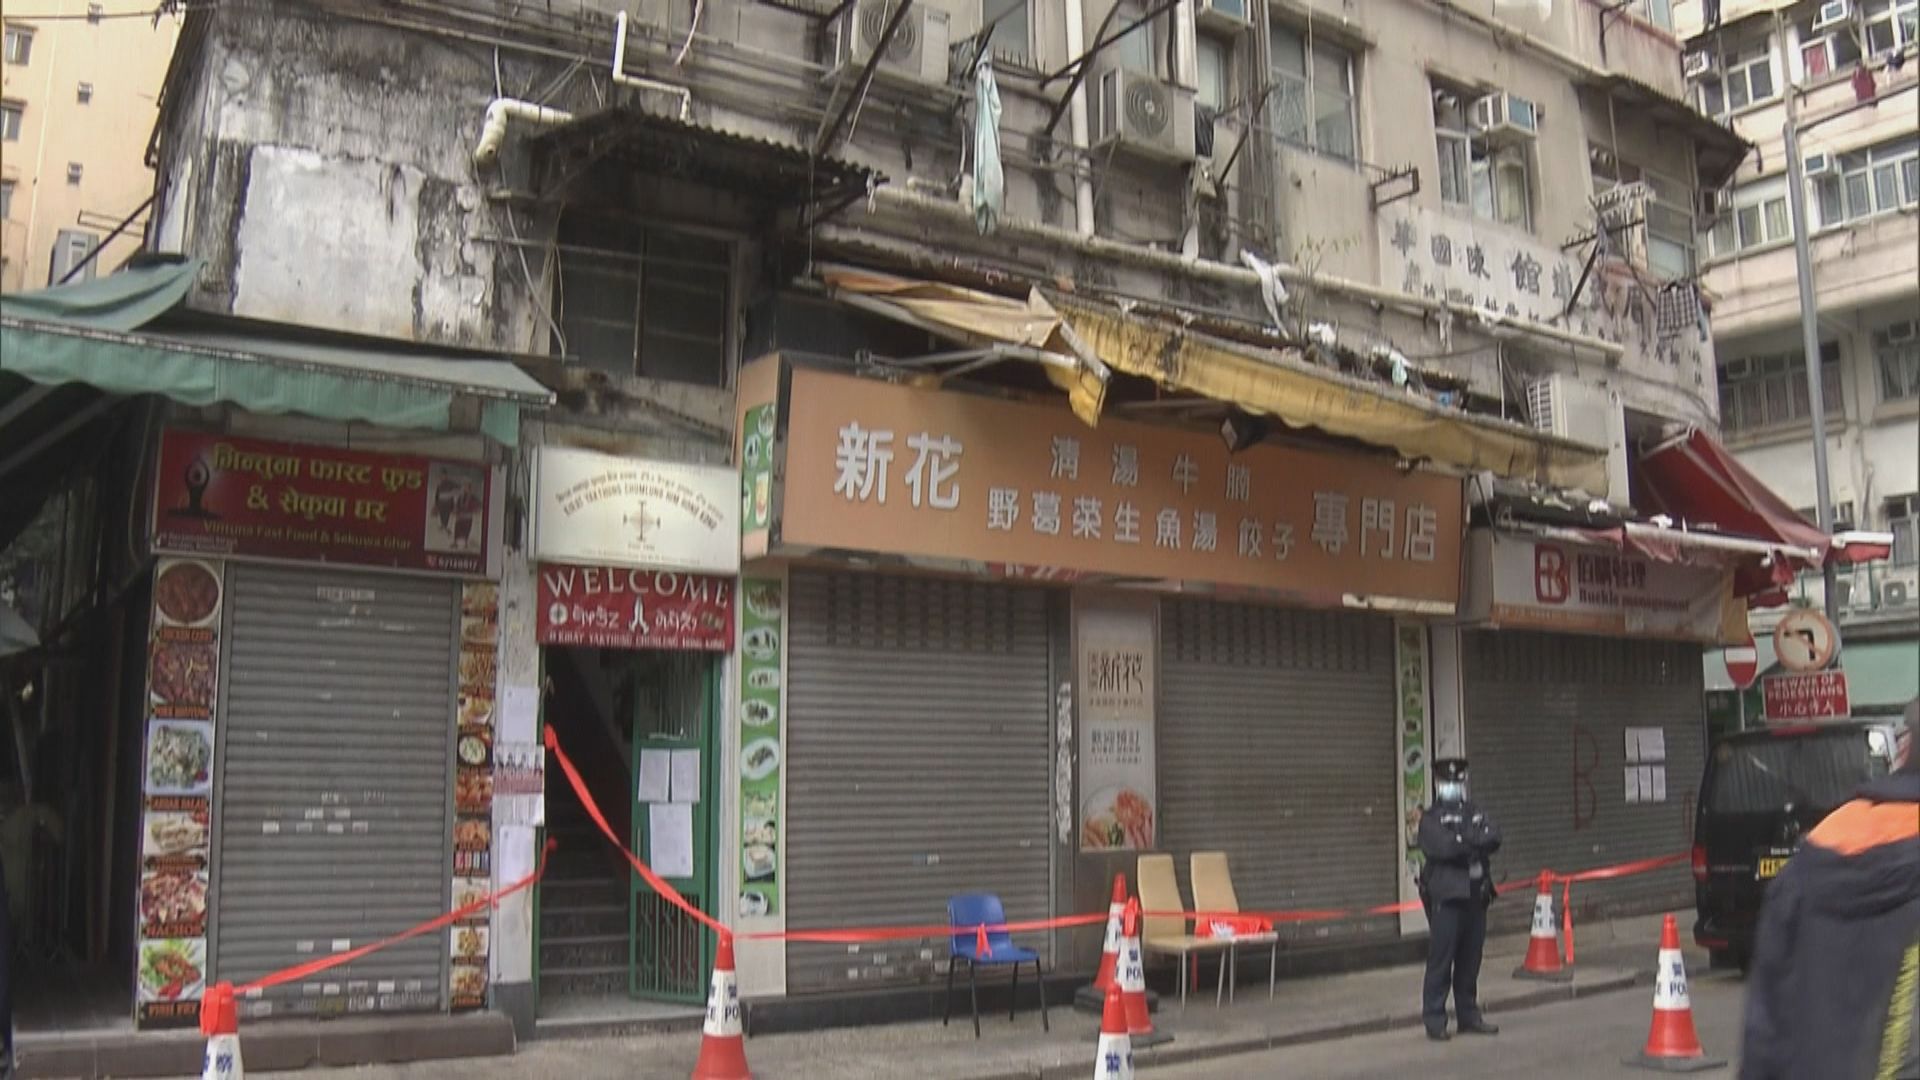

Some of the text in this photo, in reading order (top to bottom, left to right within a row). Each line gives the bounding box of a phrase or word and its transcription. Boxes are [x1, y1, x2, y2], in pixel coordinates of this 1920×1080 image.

[834, 420, 963, 509] 新花
[247, 485, 269, 510] &
[257, 524, 282, 539] Fast
[286, 526, 318, 541] Food
[320, 529, 329, 544] &
[1238, 517, 1297, 561] 餃子
[1310, 490, 1438, 561] 專門店
[544, 567, 729, 609] WELCOME
